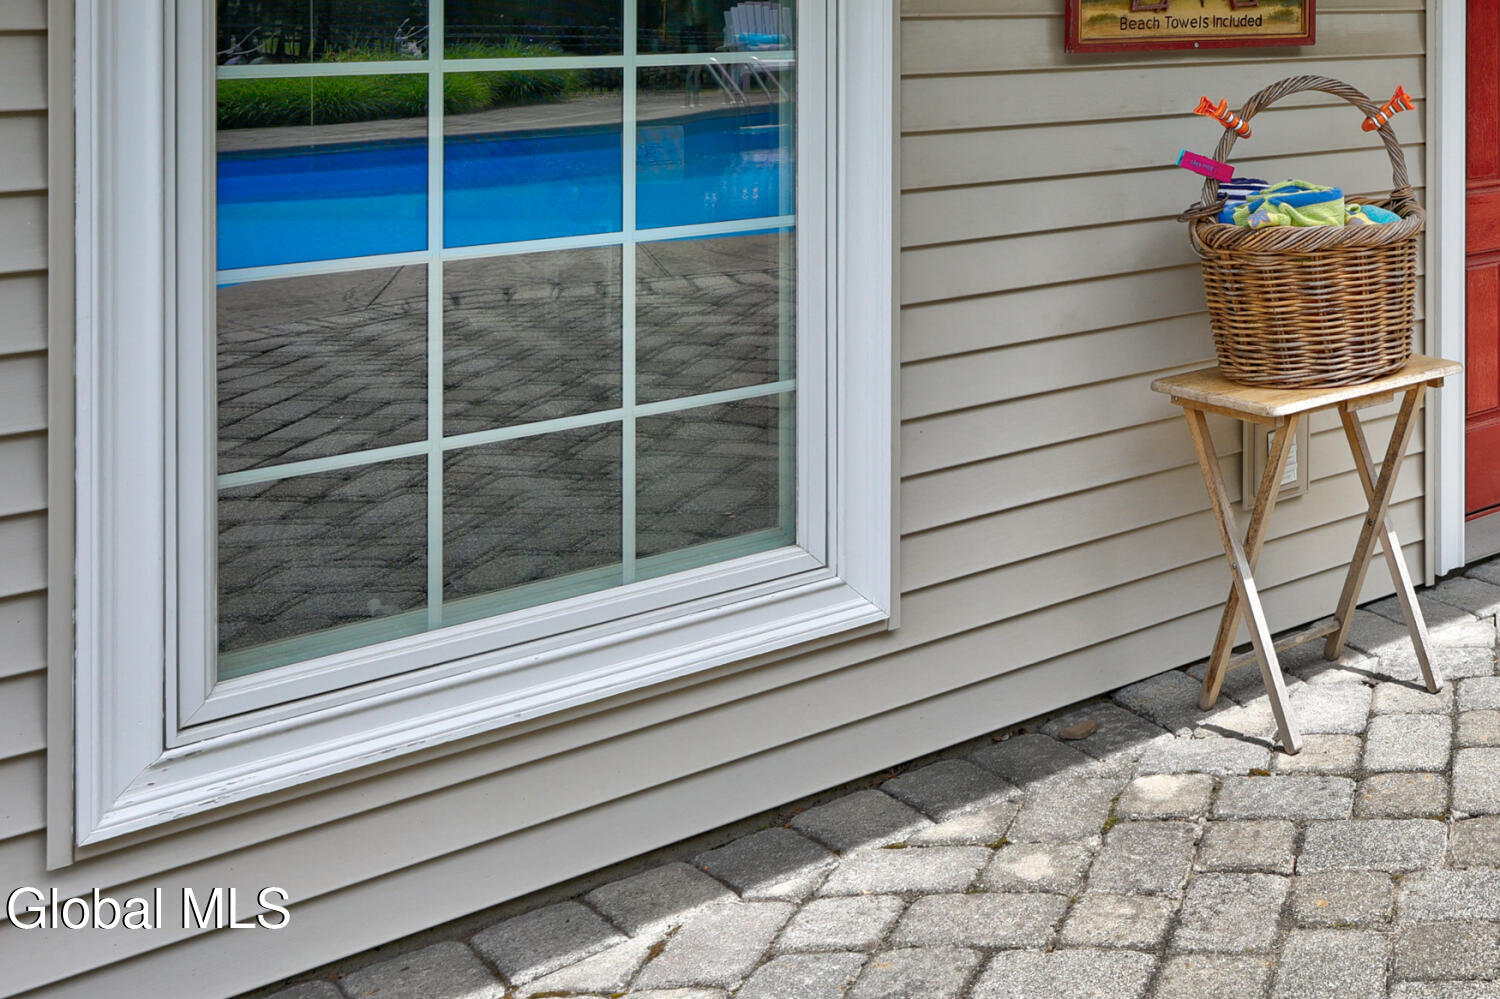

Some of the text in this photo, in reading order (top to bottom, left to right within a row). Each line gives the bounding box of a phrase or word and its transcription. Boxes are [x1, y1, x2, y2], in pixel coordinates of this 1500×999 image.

[1119, 14, 1263, 31] Beach Towels Included
